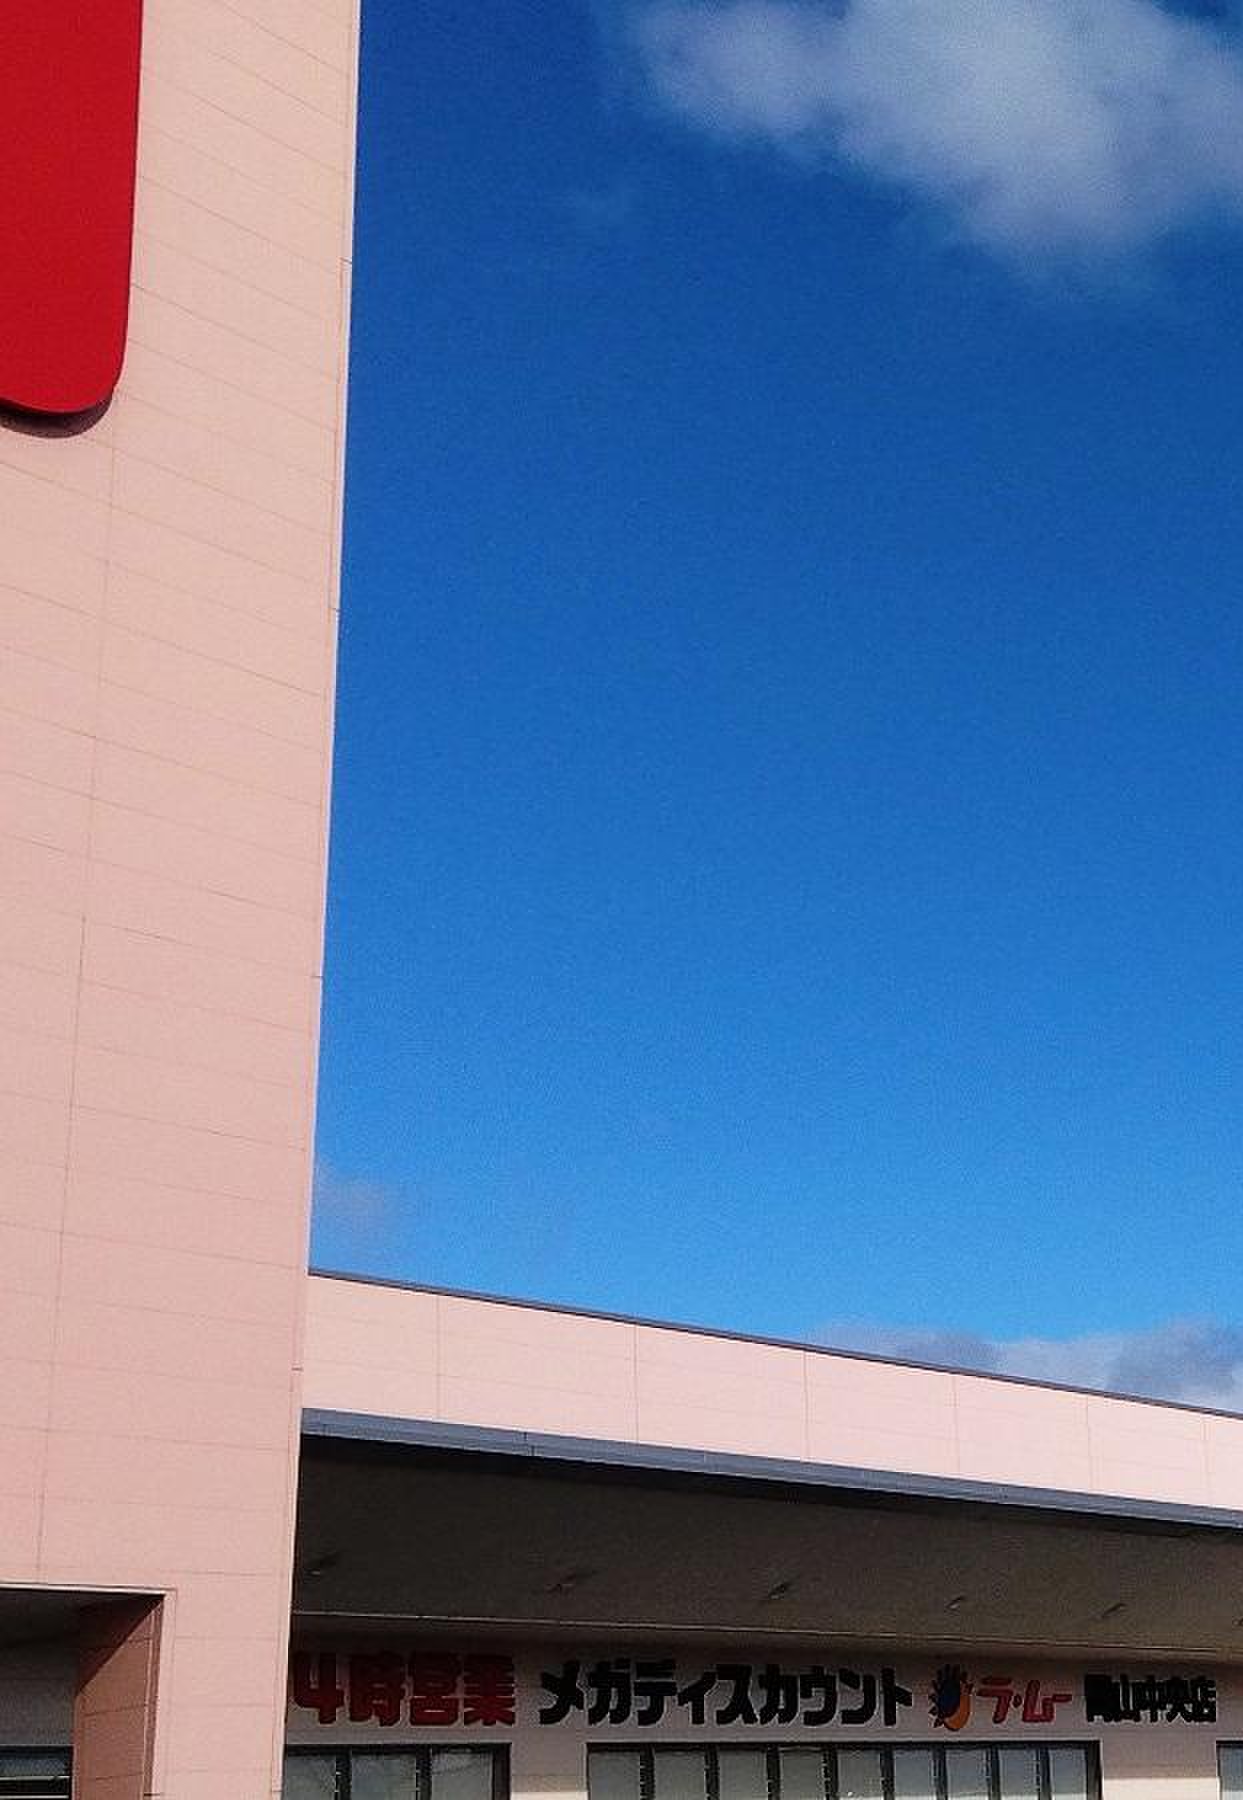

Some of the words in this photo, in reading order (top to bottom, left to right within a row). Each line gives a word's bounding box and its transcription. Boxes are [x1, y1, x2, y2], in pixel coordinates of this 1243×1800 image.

[540, 1658, 912, 1725] メガディスカウント
